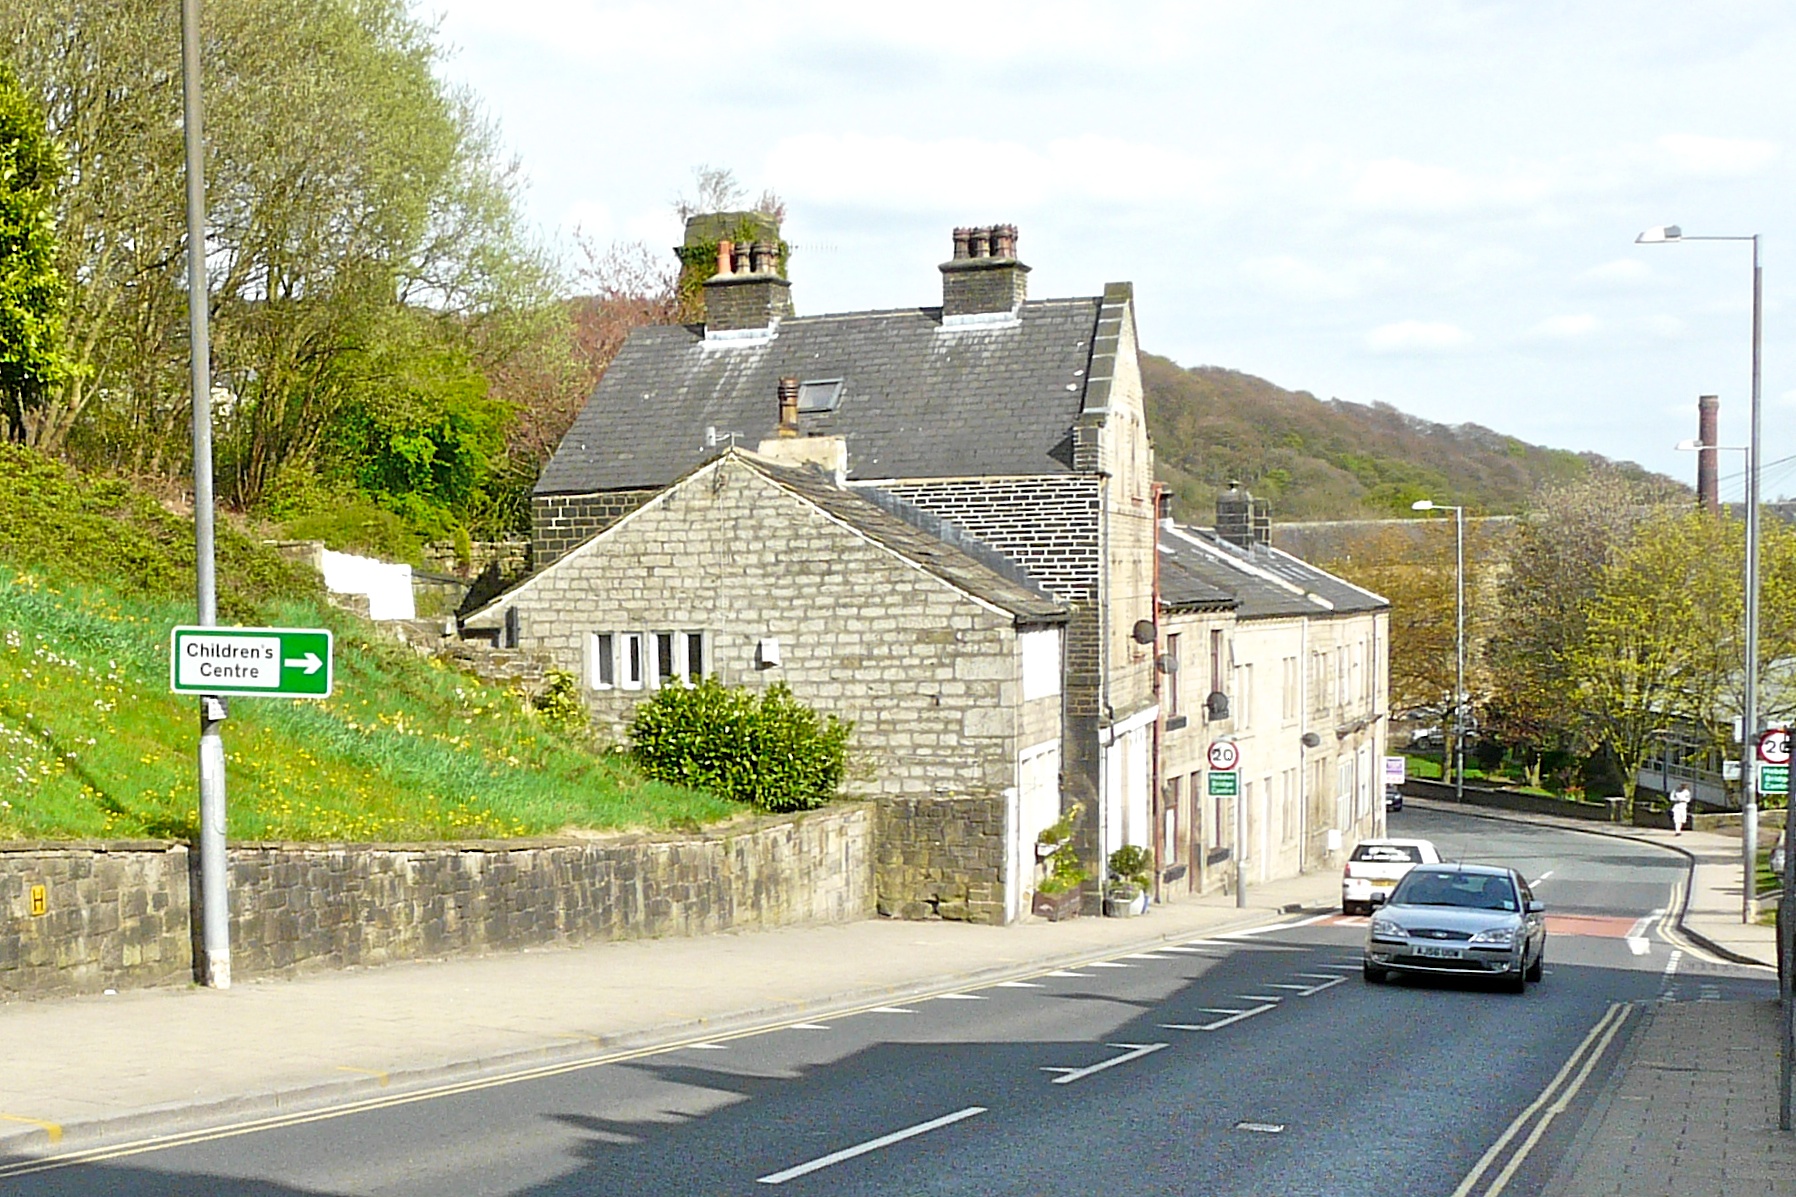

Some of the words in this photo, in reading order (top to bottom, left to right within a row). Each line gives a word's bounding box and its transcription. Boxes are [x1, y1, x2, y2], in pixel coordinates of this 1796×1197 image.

[186, 643, 274, 659] Children's
[200, 662, 260, 678] Centre
[1212, 748, 1234, 761] 20
[1211, 780, 1234, 788] Bridge
[33, 888, 43, 911] H
